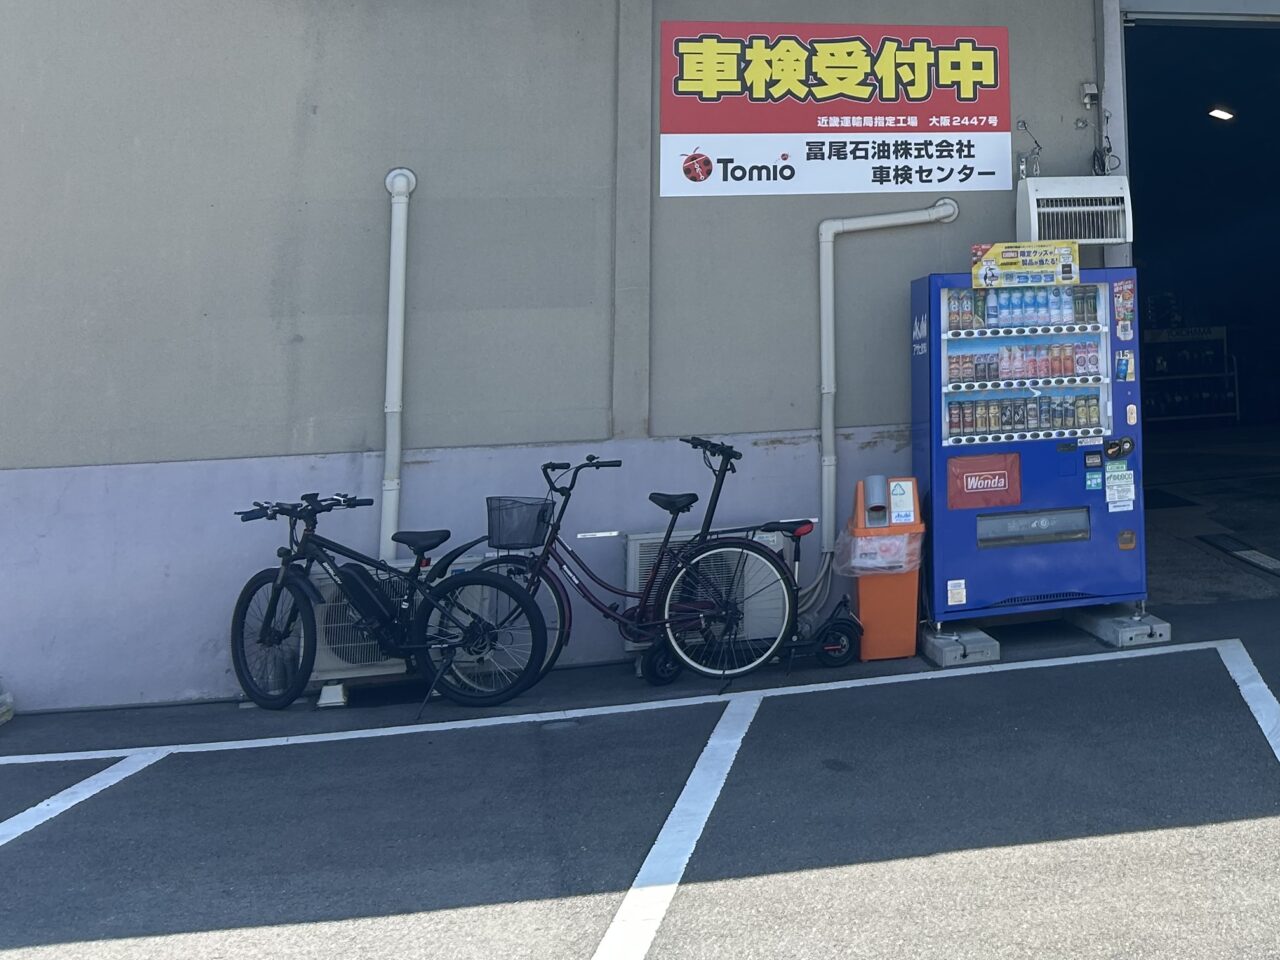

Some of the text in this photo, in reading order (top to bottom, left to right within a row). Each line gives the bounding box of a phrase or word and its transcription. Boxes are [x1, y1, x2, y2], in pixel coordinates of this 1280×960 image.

[674, 33, 998, 102] 車検受付中
[929, 116, 998, 126] 大阪2447号
[716, 158, 796, 182] Tomio
[871, 165, 996, 185] 車検センター
[967, 475, 1005, 490] Wonda
